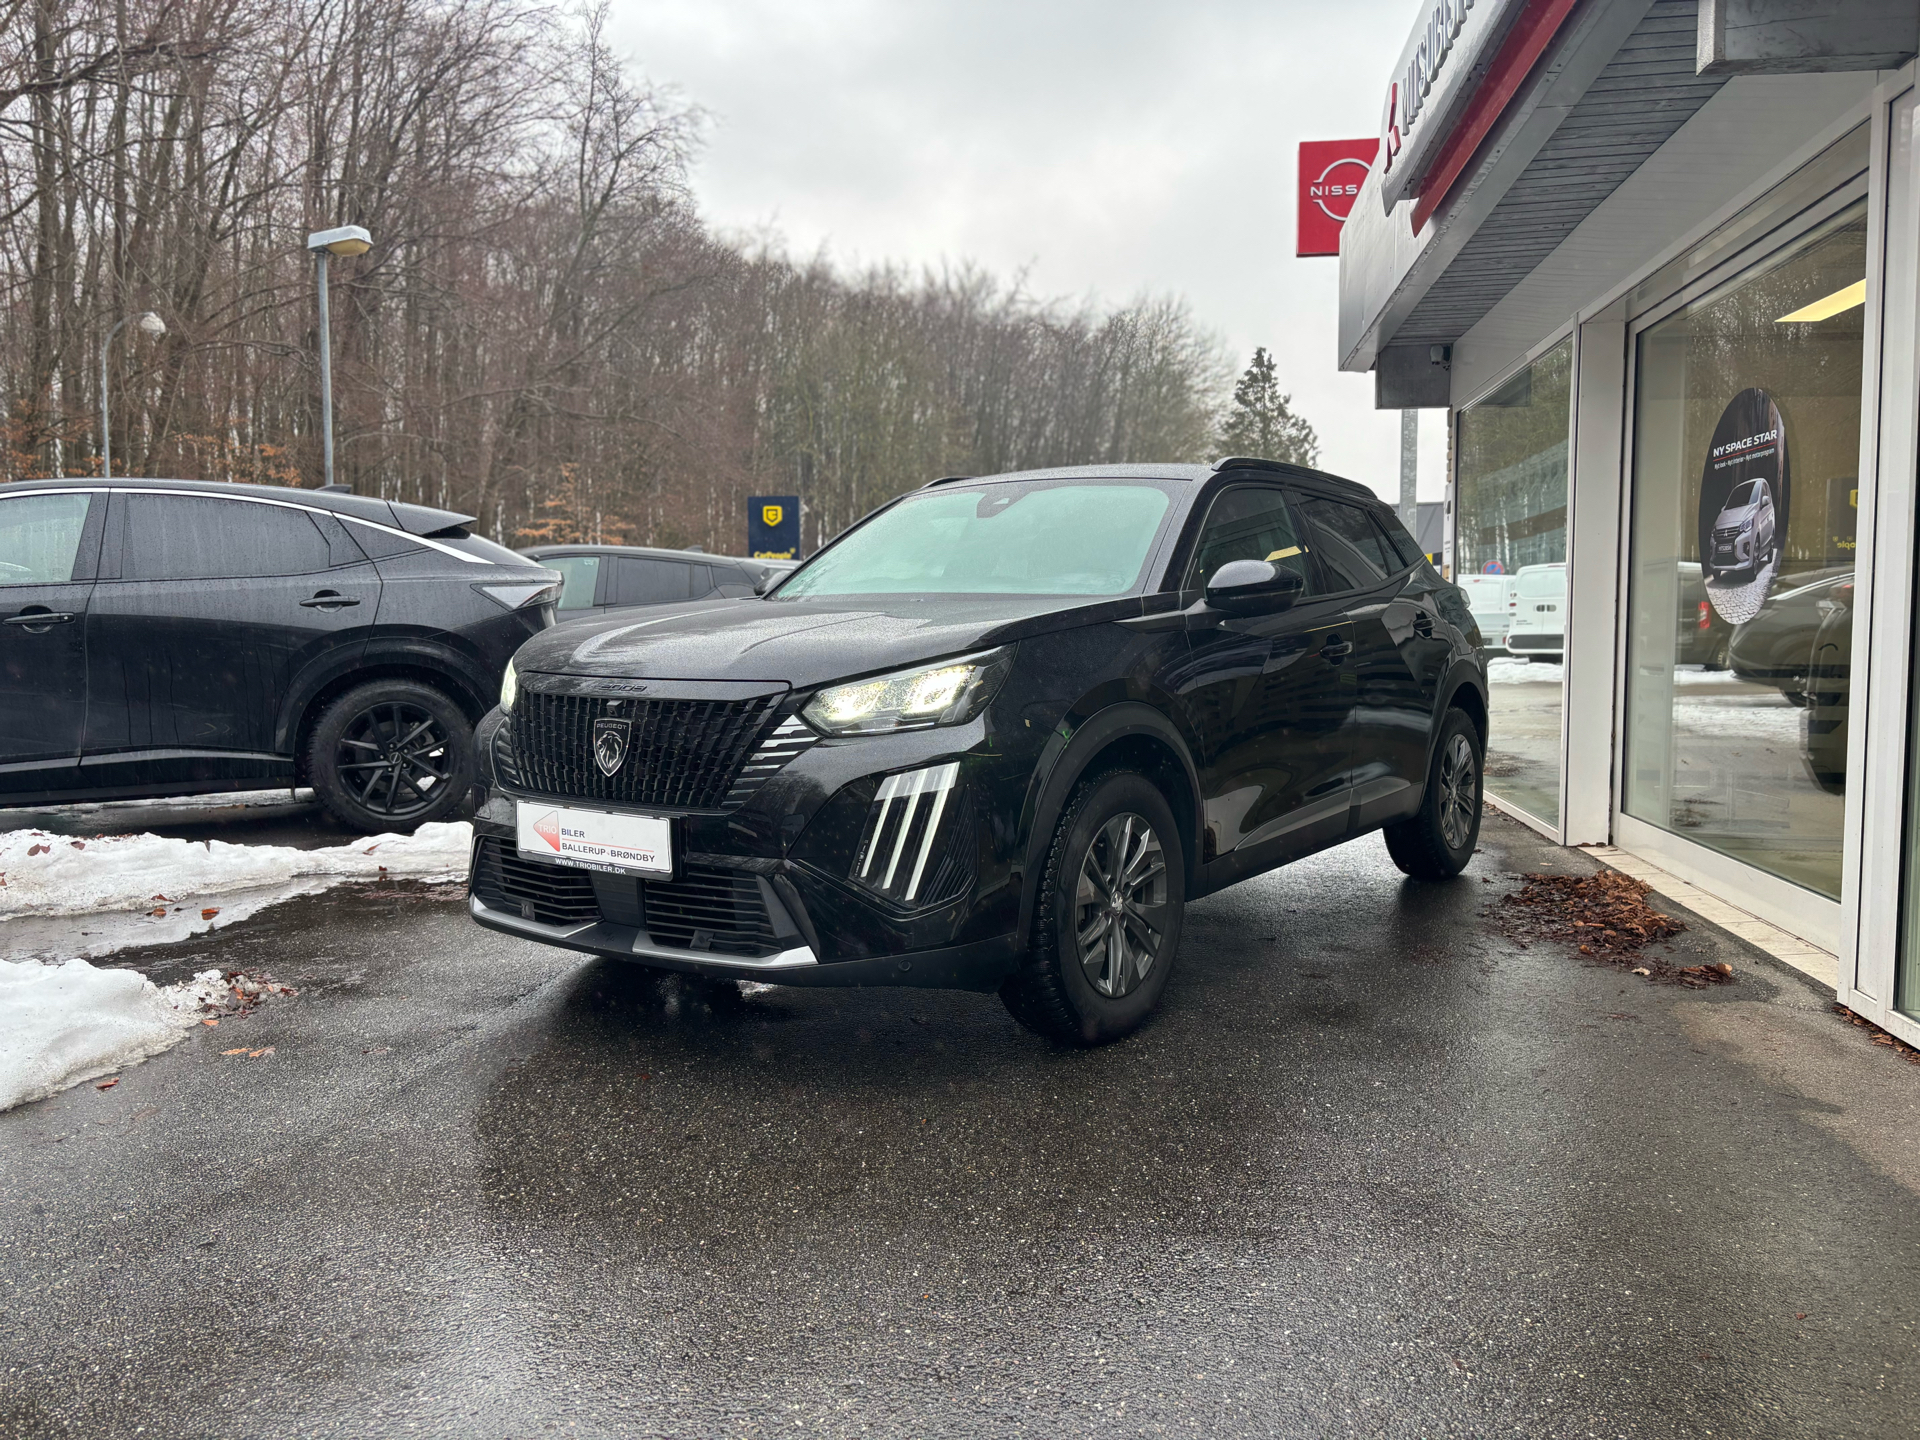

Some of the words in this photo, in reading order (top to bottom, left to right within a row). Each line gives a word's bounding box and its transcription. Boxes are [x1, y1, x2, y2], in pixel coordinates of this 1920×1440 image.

[1402, 0, 1474, 137] MITSUBIS
[1713, 445, 1725, 458] NY
[1725, 437, 1753, 454] SPACE
[1753, 429, 1778, 445] STAR
[596, 722, 628, 730] PEUGEOT
[538, 823, 558, 835] TRIO
[561, 828, 586, 838] BILER
[554, 857, 627, 875] WWW.TRIOBILER.DK
